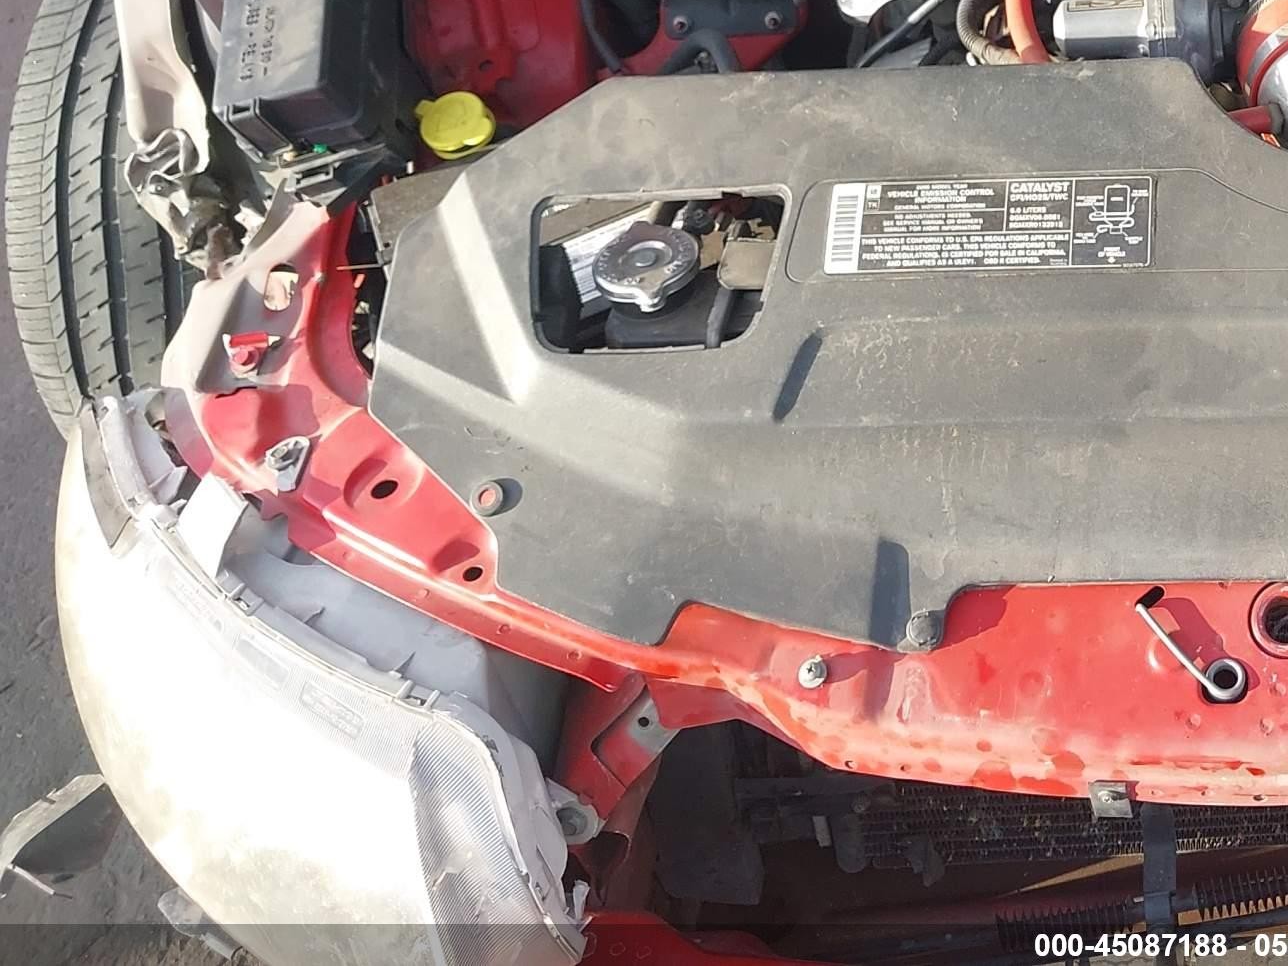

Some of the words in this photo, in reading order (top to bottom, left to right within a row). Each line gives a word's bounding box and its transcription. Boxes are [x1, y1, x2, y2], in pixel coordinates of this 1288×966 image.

[1010, 182, 1070, 193] CATALYST
[878, 237, 905, 245] VEHICLE
[980, 242, 1007, 250] VEHICLE
[862, 252, 892, 260] FEDERAL
[950, 250, 984, 258] CERTIFIED
[1000, 249, 1017, 257] SALE
[887, 259, 901, 267] AND
[937, 258, 947, 266] AS
